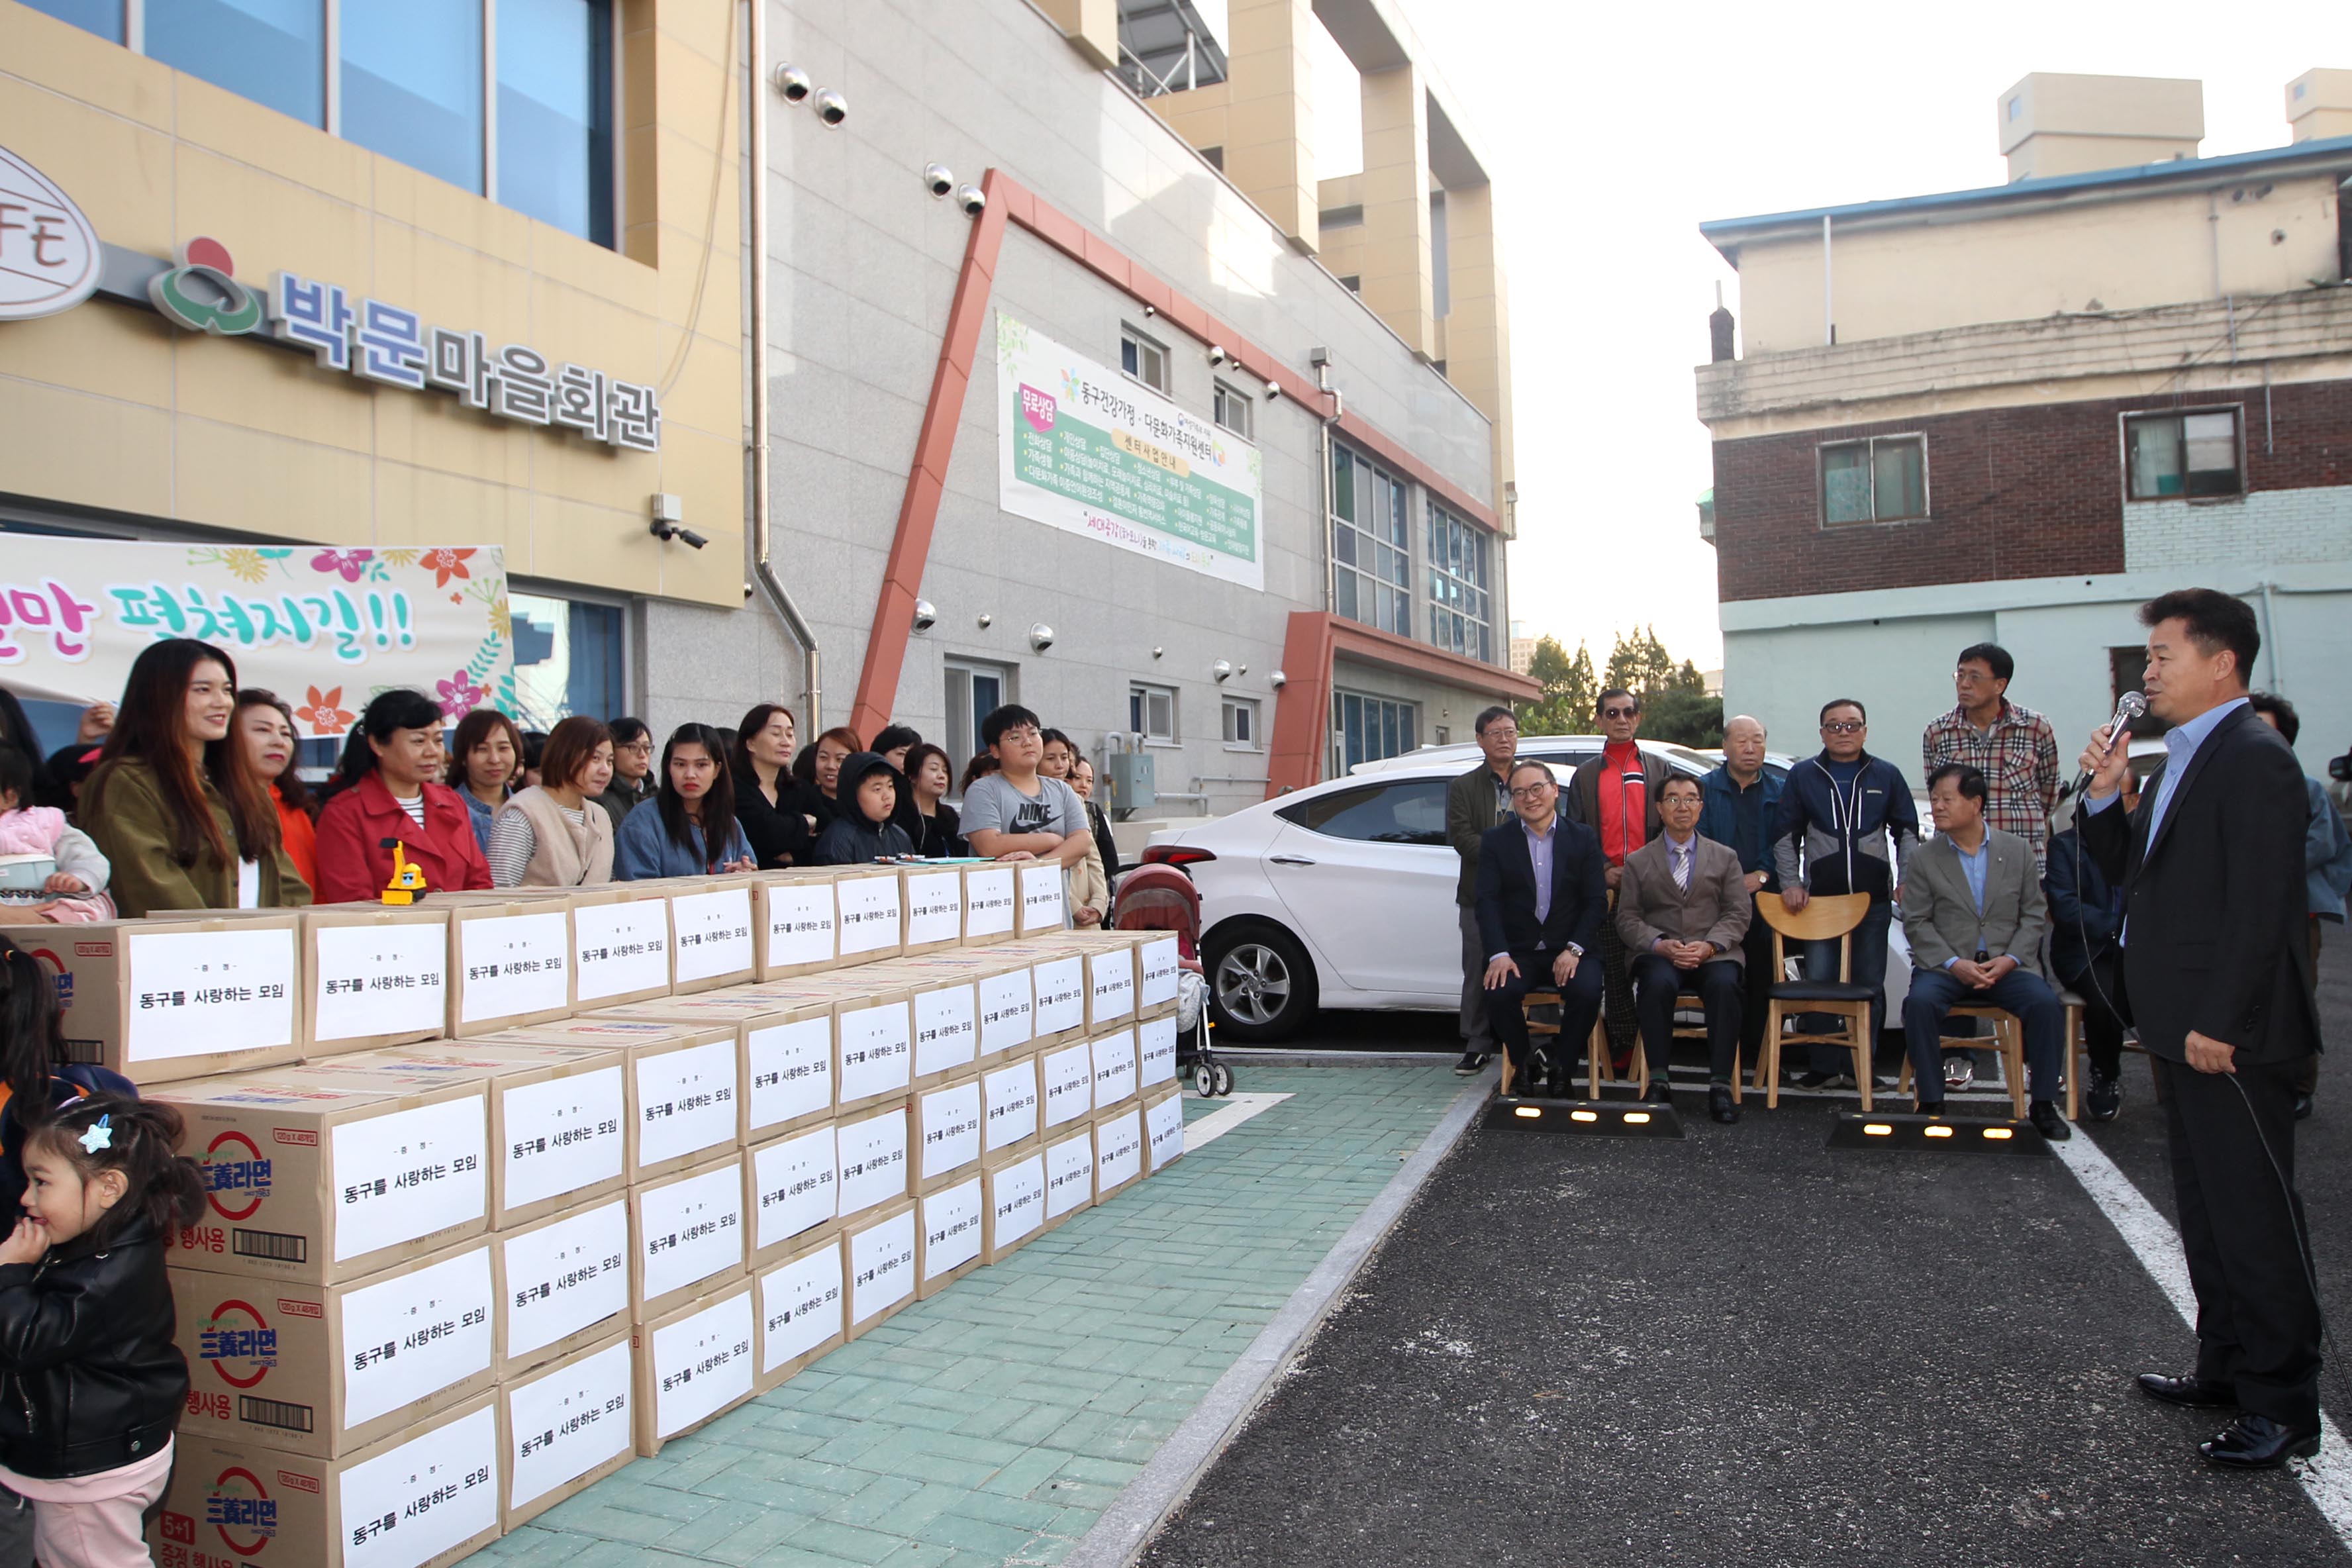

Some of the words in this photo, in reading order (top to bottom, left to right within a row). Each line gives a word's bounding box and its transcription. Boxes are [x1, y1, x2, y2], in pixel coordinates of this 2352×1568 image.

[279, 271, 660, 452] 박문마을회관
[1022, 389, 1054, 422] 무료상담
[1081, 381, 1135, 426] 동구건강가정
[1145, 413, 1211, 462] 다문화가족지원센터
[1027, 431, 1052, 452] 전화상담
[1018, 803, 1051, 822] NIKE
[680, 934, 702, 948] 동구를
[705, 930, 732, 942] 사랑하는
[734, 926, 748, 938] 모임
[773, 922, 792, 934] 동구를
[794, 921, 818, 932] 사랑하는
[820, 920, 832, 930] 모임
[582, 948, 609, 963] 동구를
[612, 943, 644, 957] 사랑하는
[647, 940, 663, 952] 모임
[324, 977, 364, 995] 동구를
[369, 974, 416, 991] 사랑하는
[420, 971, 440, 987] 모임
[468, 963, 499, 981] 동구를
[503, 959, 542, 976] 사랑하는
[544, 956, 562, 970] 모임
[138, 990, 187, 1010] 동구를
[193, 986, 253, 1005] 사랑하는
[258, 983, 284, 999] 모임
[919, 1029, 937, 1043] 동구를
[938, 1024, 959, 1037] 사랑하는
[961, 1020, 972, 1032] 모임
[845, 1051, 866, 1066] 동구를
[868, 1046, 893, 1060] 사랑하는
[895, 1041, 906, 1054] 모임
[754, 1071, 779, 1089] 동구를
[781, 1065, 810, 1081] 사랑하는
[813, 1059, 826, 1073] 모임
[645, 1101, 674, 1122] 동구를
[677, 1093, 712, 1112] 사랑하는
[714, 1086, 732, 1102] 모임
[512, 1136, 547, 1160] 동구를
[550, 1126, 593, 1148] 사랑하는
[597, 1118, 618, 1136] 모임
[926, 1130, 944, 1145] 동구를
[945, 1124, 965, 1137] 사랑하는
[967, 1118, 977, 1130] 모임
[343, 1177, 388, 1204] 동구를
[393, 1163, 447, 1189] 사랑하는
[452, 1153, 477, 1174] 모임
[844, 1163, 863, 1181] 동구를
[865, 1155, 889, 1171] 사랑하는
[891, 1149, 903, 1161] 모임
[762, 1188, 785, 1208] 동구를
[789, 1178, 817, 1196] 사랑하는
[819, 1169, 833, 1184] 모임
[180, 1227, 225, 1253] 행사용
[648, 1232, 678, 1255] 동구를
[680, 1220, 717, 1242] 사랑하는
[719, 1211, 737, 1229] 모임
[929, 1230, 946, 1246] 동구를
[947, 1221, 968, 1236] 사랑하는
[969, 1214, 979, 1227] 모임
[514, 1281, 552, 1308] 동구를
[555, 1265, 599, 1291] 사랑하는
[601, 1252, 622, 1273] 모임
[856, 1269, 875, 1287] 동구를
[877, 1258, 899, 1275] 사랑하는
[901, 1250, 912, 1263] 모임
[768, 1310, 791, 1332] 동구를
[794, 1297, 822, 1318] 사랑하는
[824, 1286, 838, 1302] 모임
[200, 1328, 277, 1359] 三養라면
[353, 1340, 397, 1371] 동구를
[403, 1320, 456, 1351] 사랑하는
[460, 1305, 485, 1329] 모임
[662, 1367, 693, 1393] 동구를
[695, 1351, 730, 1376] 사랑하는
[732, 1338, 750, 1357] 모임
[186, 1391, 231, 1420] 행사용
[520, 1428, 555, 1459] 동구를
[558, 1408, 601, 1438] 사랑하는
[605, 1393, 625, 1415] 모임
[207, 1497, 277, 1527] 三養라면
[352, 1510, 398, 1547] 동구를
[403, 1483, 459, 1520] 사랑하는
[464, 1464, 489, 1490] 모임
[165, 1515, 189, 1540] 5+1
